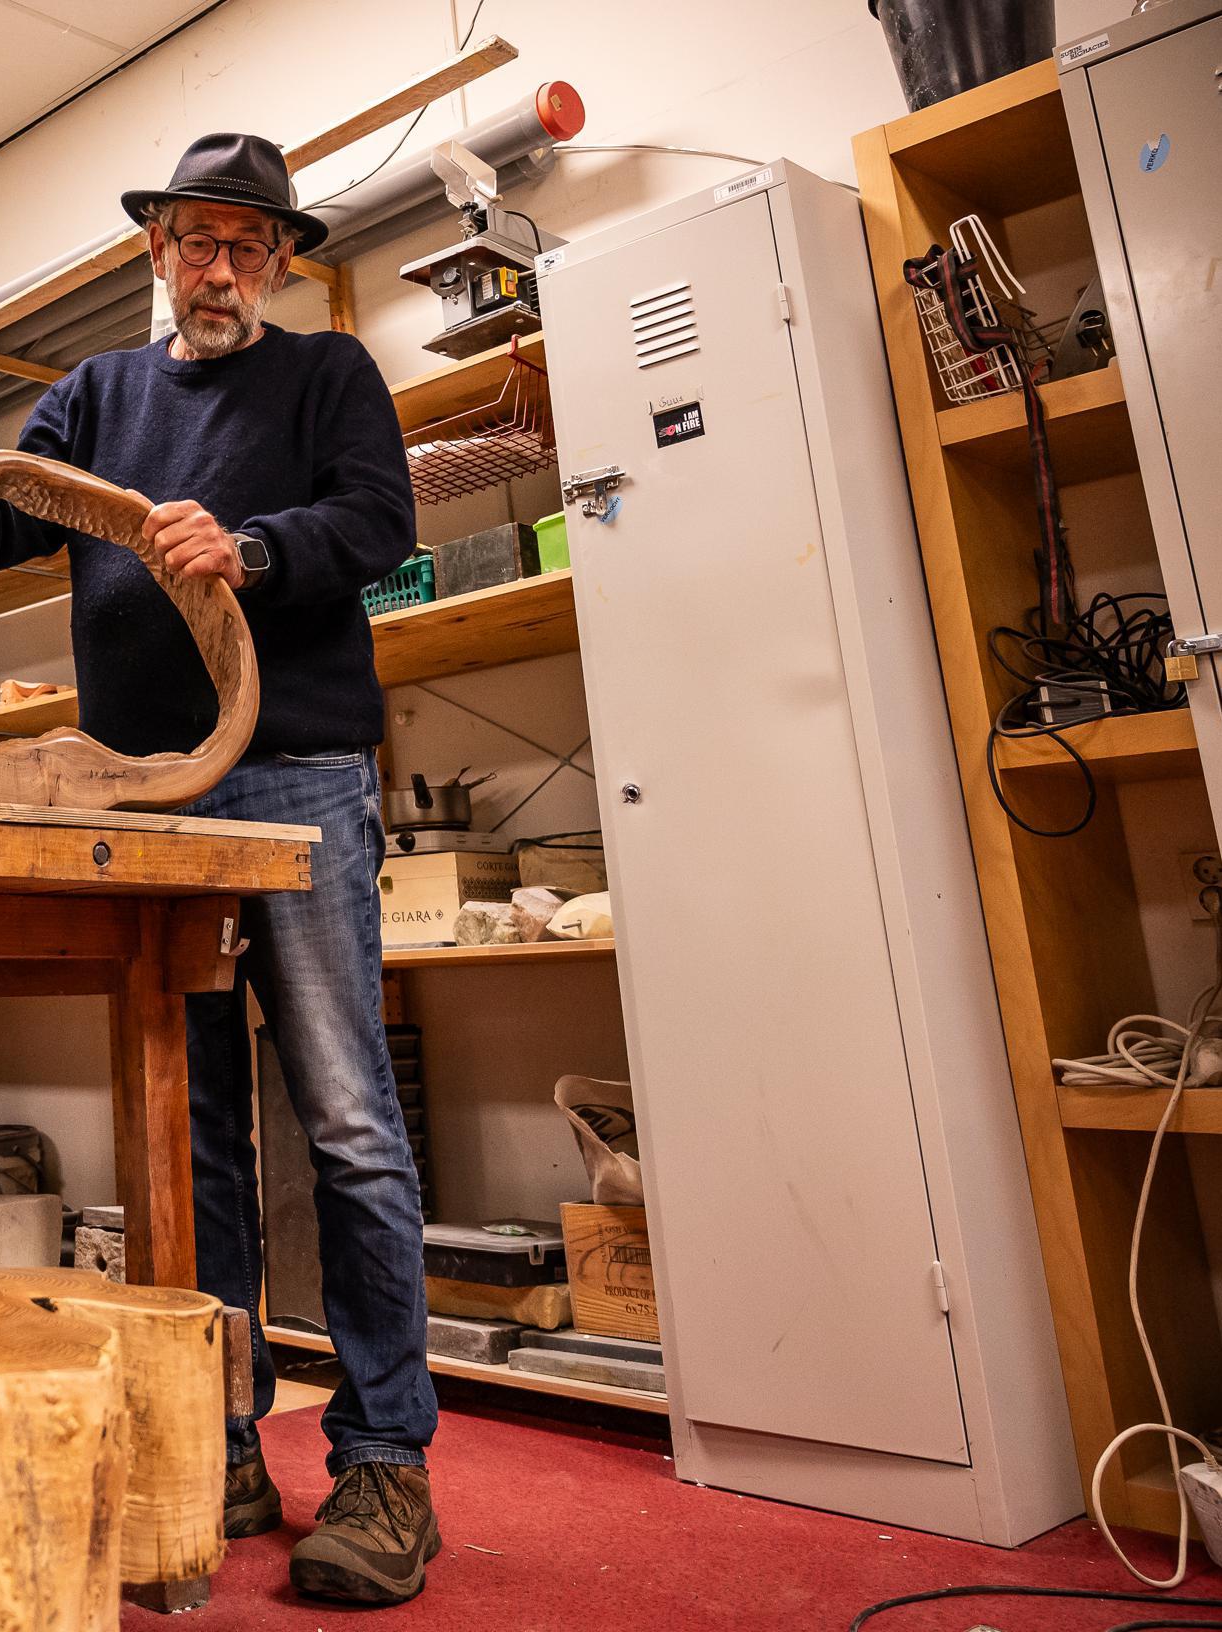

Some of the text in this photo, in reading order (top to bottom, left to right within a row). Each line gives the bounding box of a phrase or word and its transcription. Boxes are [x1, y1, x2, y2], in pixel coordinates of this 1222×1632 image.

[683, 409, 699, 421] I AM
[682, 417, 701, 431] FIRE
[391, 909, 432, 924] GIARA
[604, 1284, 639, 1299] PRODUCT
[625, 1302, 650, 1315] 6x75
